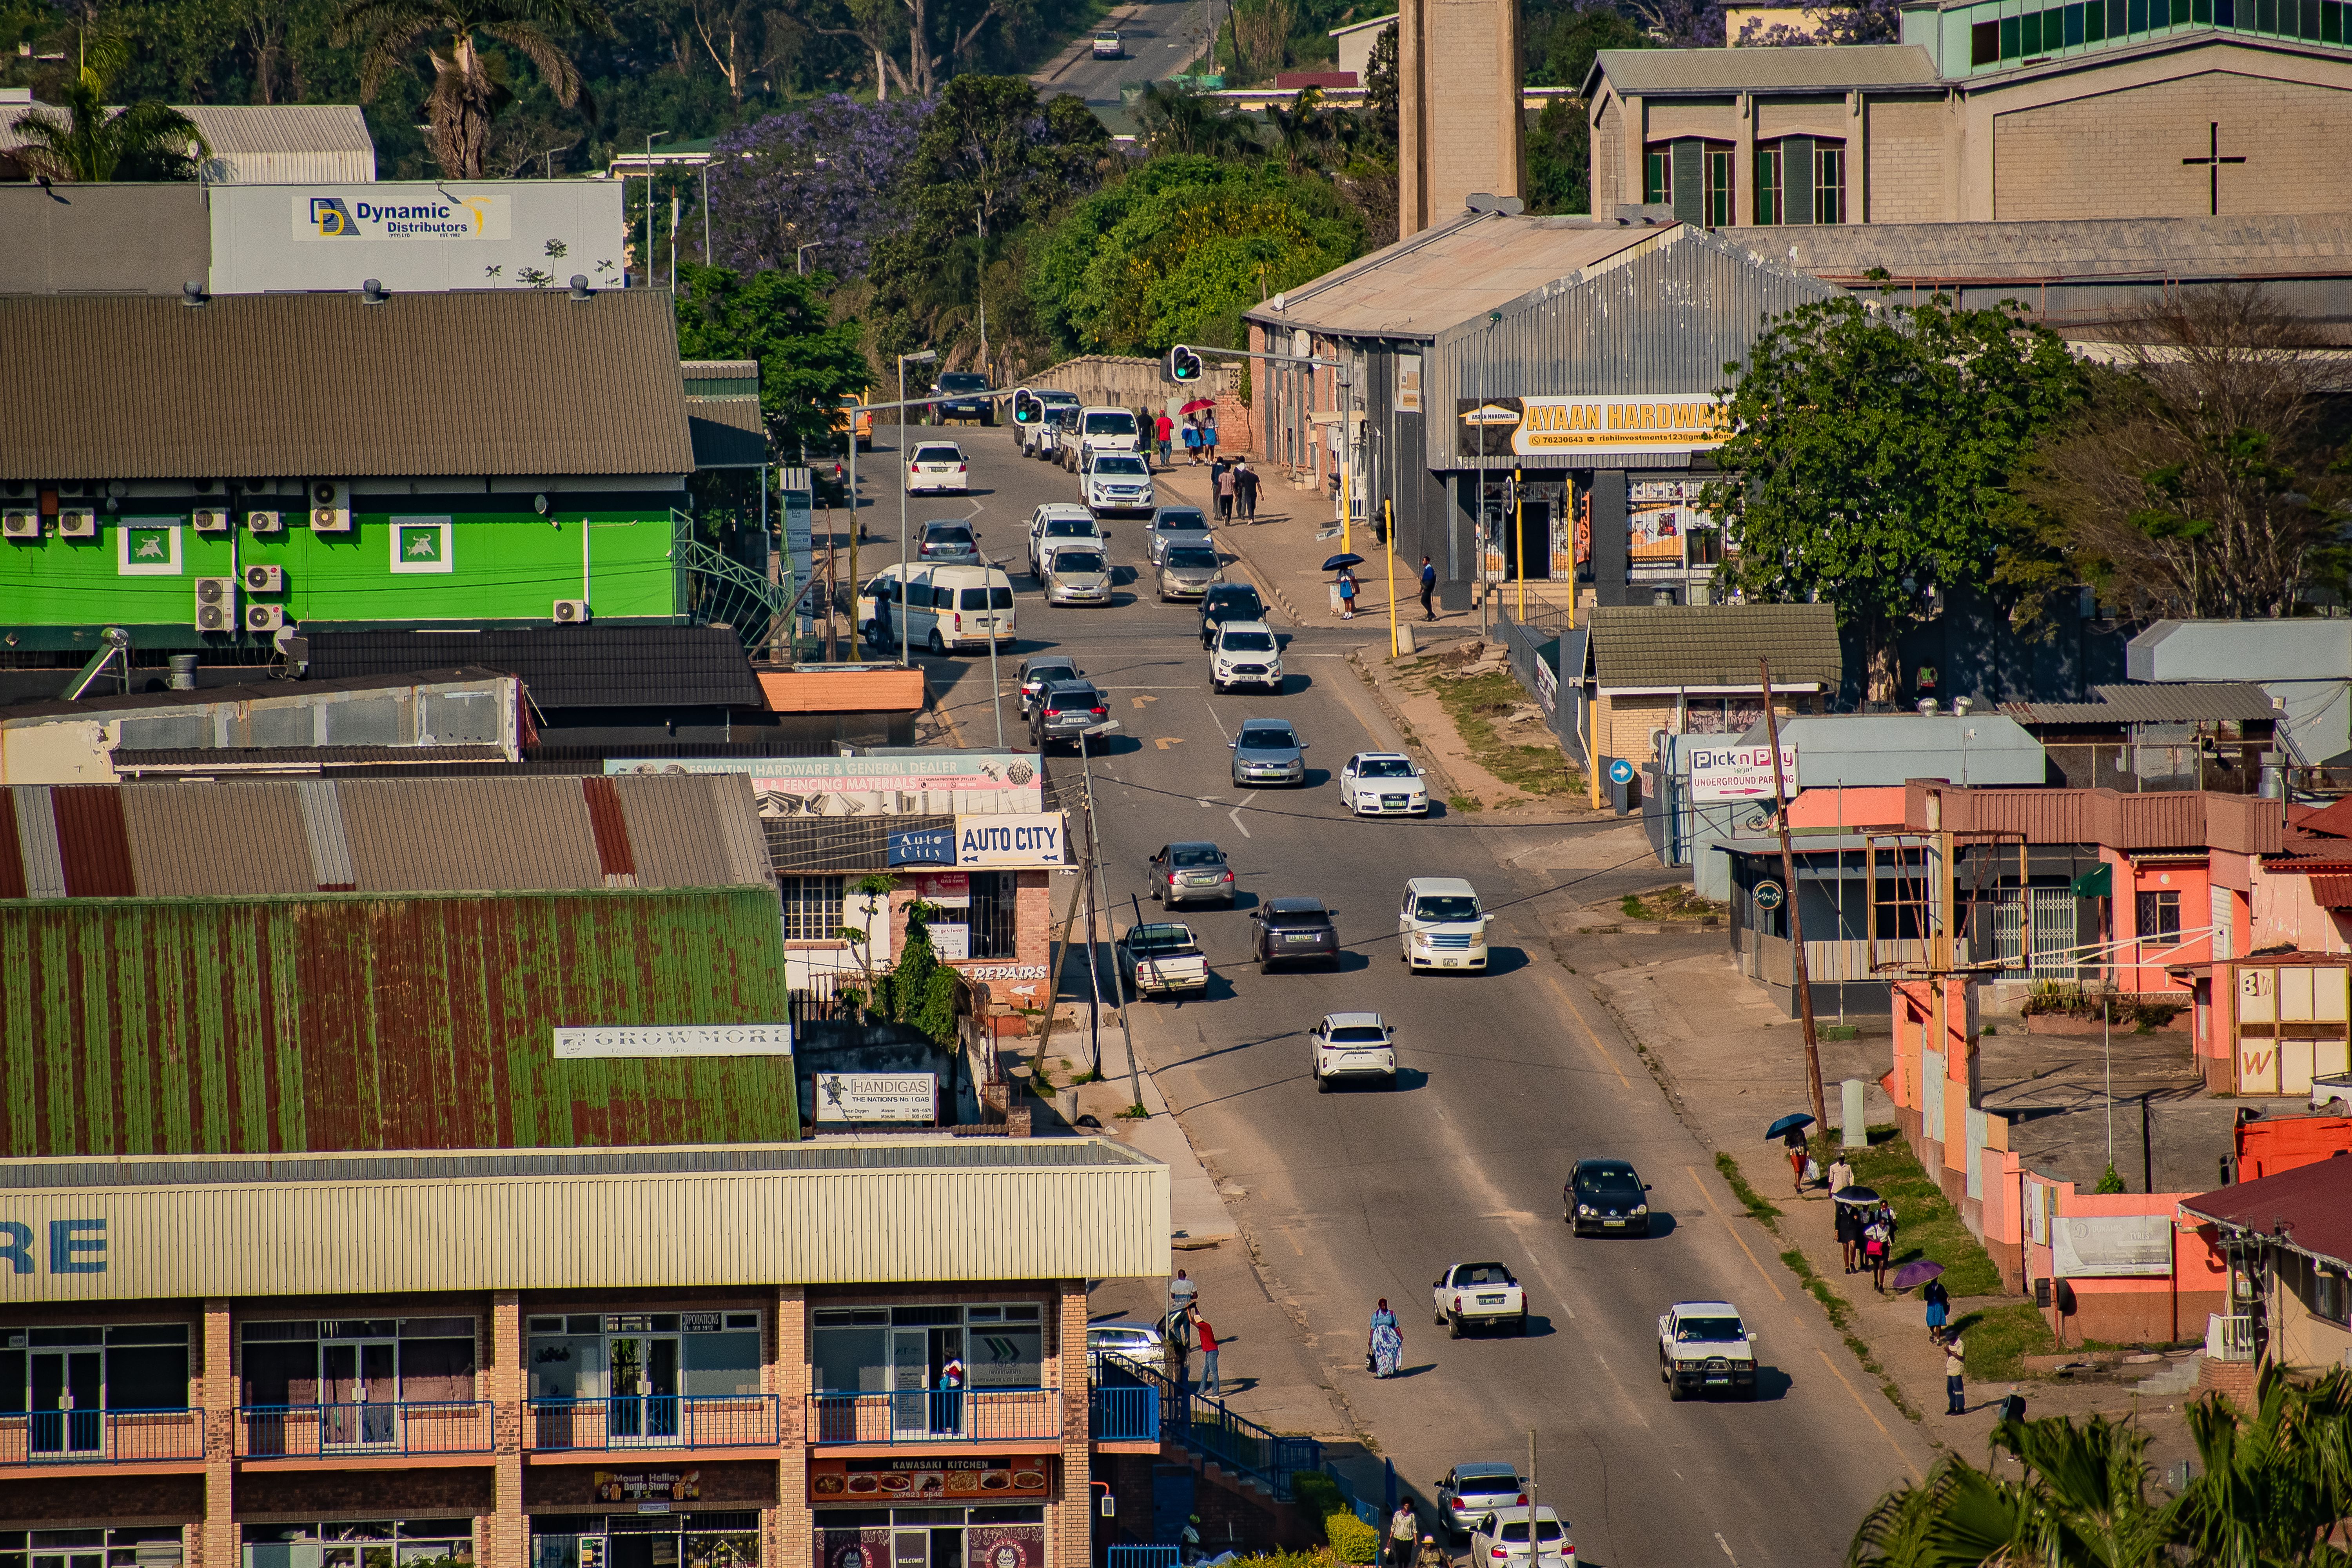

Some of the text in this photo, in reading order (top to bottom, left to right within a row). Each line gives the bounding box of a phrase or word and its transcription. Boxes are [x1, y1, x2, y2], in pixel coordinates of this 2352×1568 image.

[356, 202, 450, 223] Dynamic
[387, 221, 468, 232] Distributors
[1527, 403, 1733, 431] AYAAN HARDWAR
[1694, 716, 1719, 725] SHISA
[1694, 749, 1793, 768] Pick n Py
[756, 764, 829, 777] HARDWARE
[833, 764, 843, 775] &
[845, 763, 906, 775] GENERAL
[910, 762, 957, 774] DEALER
[770, 780, 779, 791] &
[784, 779, 842, 791] FENCING
[846, 777, 916, 790] MATERIALS
[1694, 774, 1794, 787] UNDERGROUND PARNG
[901, 834, 942, 845] Auto
[962, 827, 1057, 852] AUTO CITY
[900, 846, 940, 860] City
[974, 965, 1047, 980] REPAIRS
[594, 1029, 790, 1045] GROWMORE
[2243, 1050, 2273, 1075] W
[854, 1081, 927, 1093] HANDIGAS
[0, 1218, 107, 1274] RE
[893, 1461, 988, 1469] KAWASAKI KITCHEN
[613, 1474, 644, 1482] Mount
[624, 1482, 669, 1491] Bottle Store
[987, 1540, 1004, 1556] NANA'S
